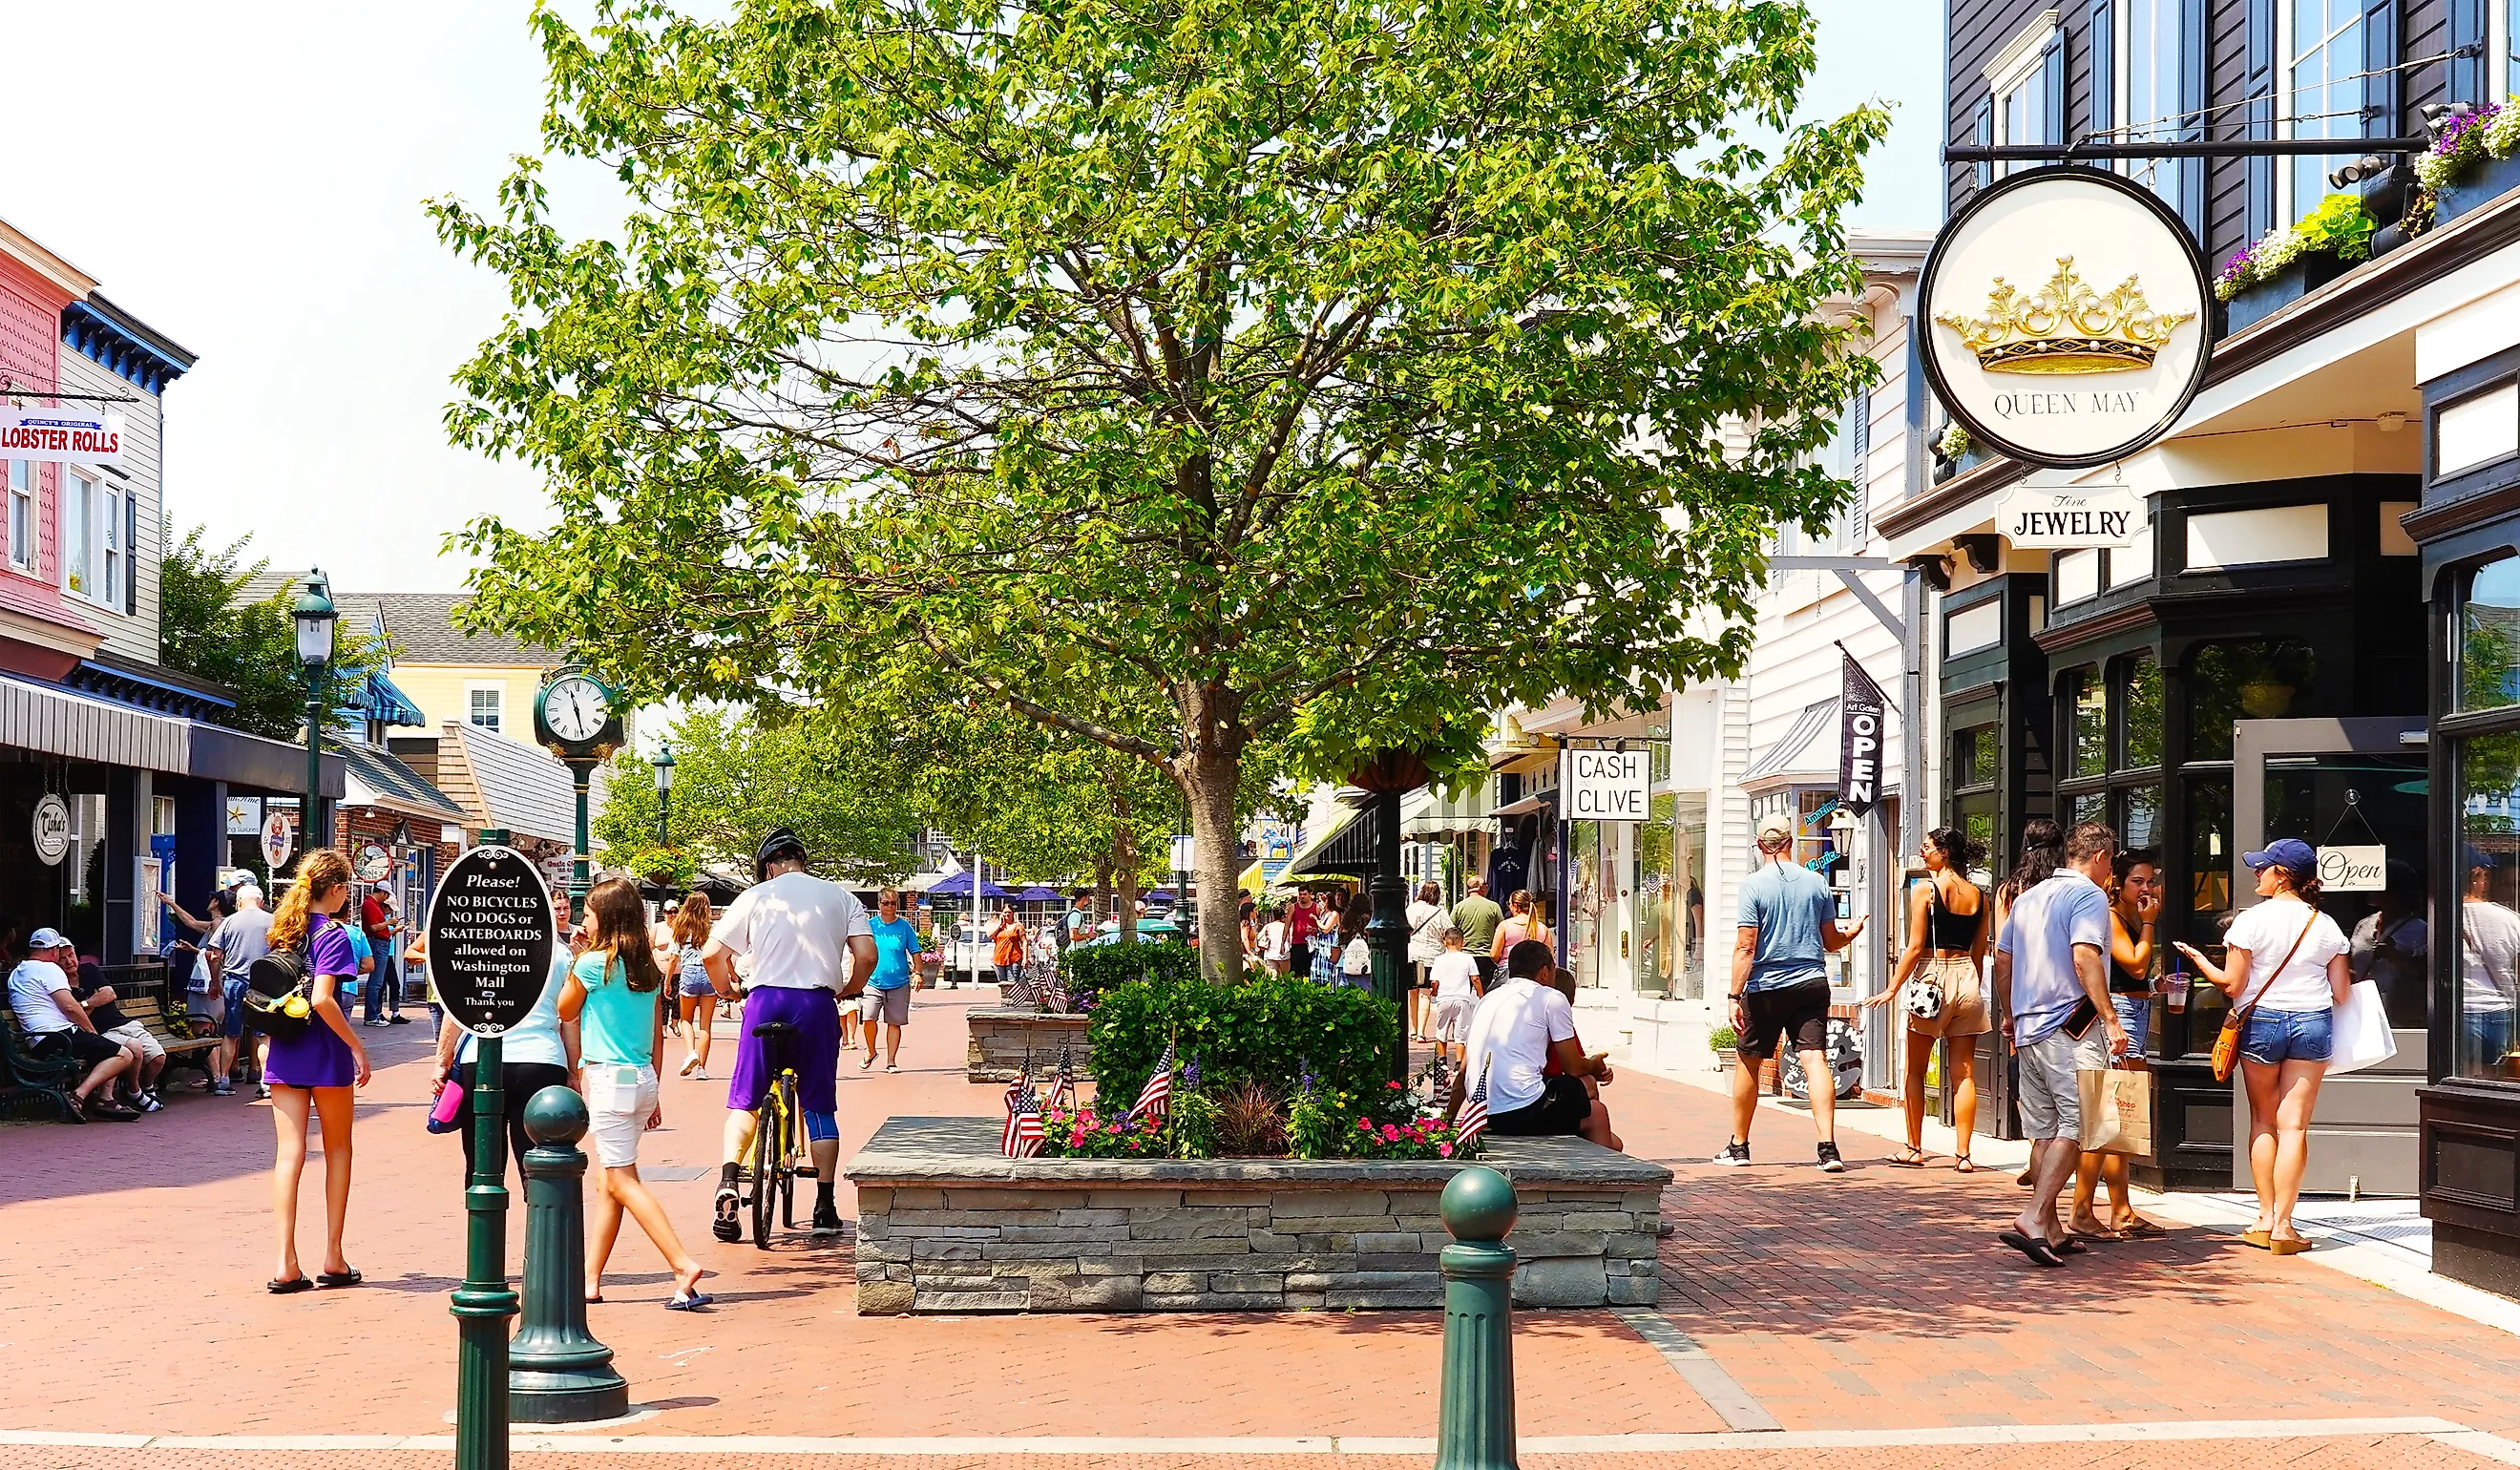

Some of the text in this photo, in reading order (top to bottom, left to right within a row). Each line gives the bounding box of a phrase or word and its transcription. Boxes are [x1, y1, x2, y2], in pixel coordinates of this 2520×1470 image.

[1994, 392, 2139, 420] QUEEN MAY
[2, 428, 118, 452] LOBSTER ROLLS
[2051, 494, 2088, 508] Fine
[2014, 511, 2132, 537] JEWELRY
[1846, 703, 1858, 711] Art
[1848, 715, 1877, 803] OPEN
[1579, 755, 1636, 779] CASH
[1579, 789, 1642, 812] CLIVE
[1804, 799, 1838, 827] Amazing
[2320, 850, 2383, 887] Open
[466, 874, 520, 888] Please!
[447, 895, 537, 908] NO BICYCLES
[450, 912, 534, 925] NO DOGS or
[440, 928, 542, 940] SKATEBOARDS
[454, 944, 527, 956] allowed on
[451, 960, 531, 975] Washington
[475, 976, 505, 988] Mall
[465, 998, 514, 1008] Thank you
